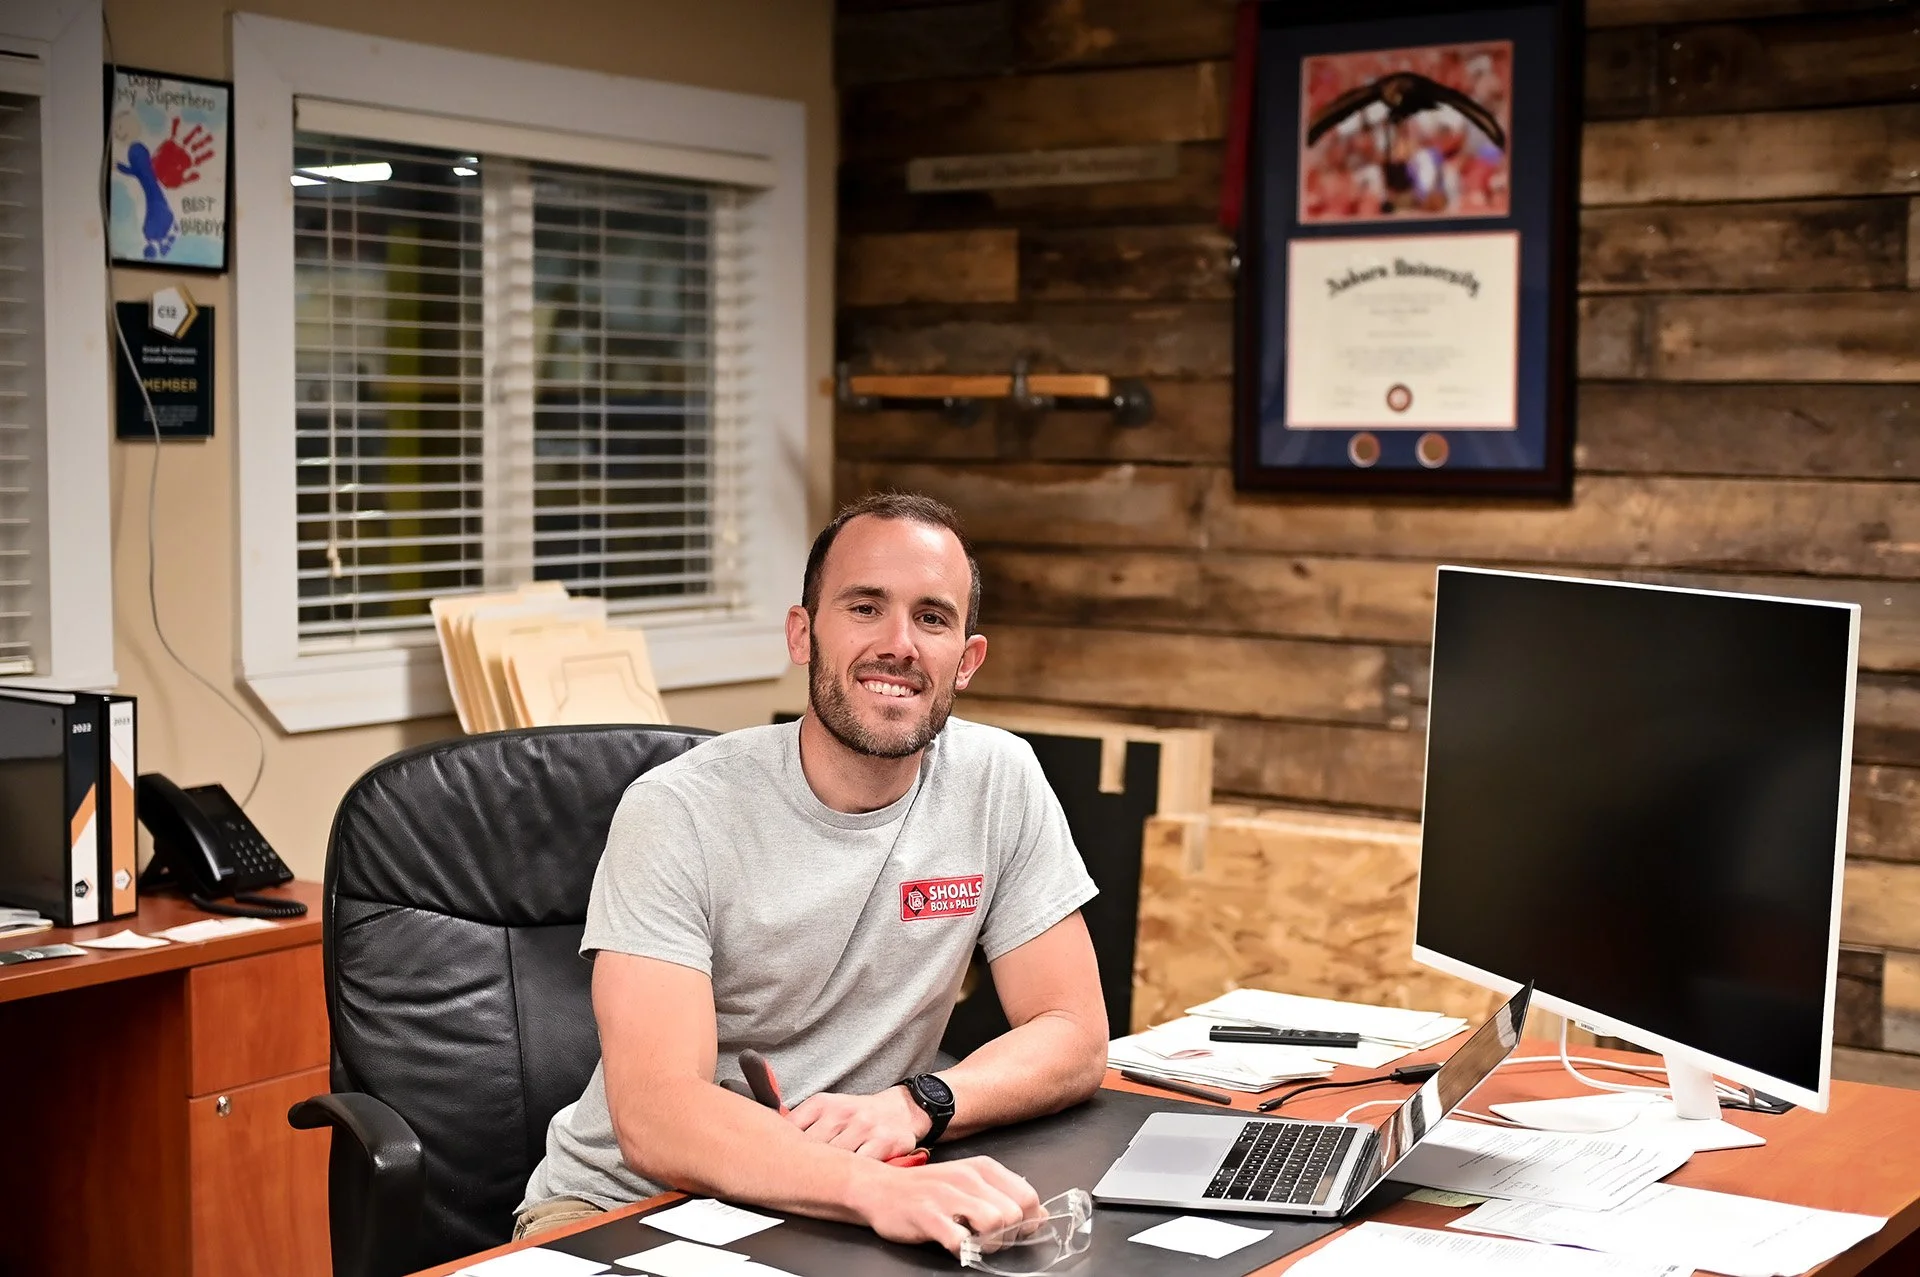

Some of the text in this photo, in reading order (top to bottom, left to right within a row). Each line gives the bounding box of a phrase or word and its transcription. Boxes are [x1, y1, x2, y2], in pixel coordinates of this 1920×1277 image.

[182, 195, 217, 214] BEST
[142, 378, 198, 393] MEMBER
[72, 722, 92, 734] 2022
[929, 881, 982, 900] SHOALS
[931, 900, 949, 912] BOX
[956, 898, 979, 909] PALLE
